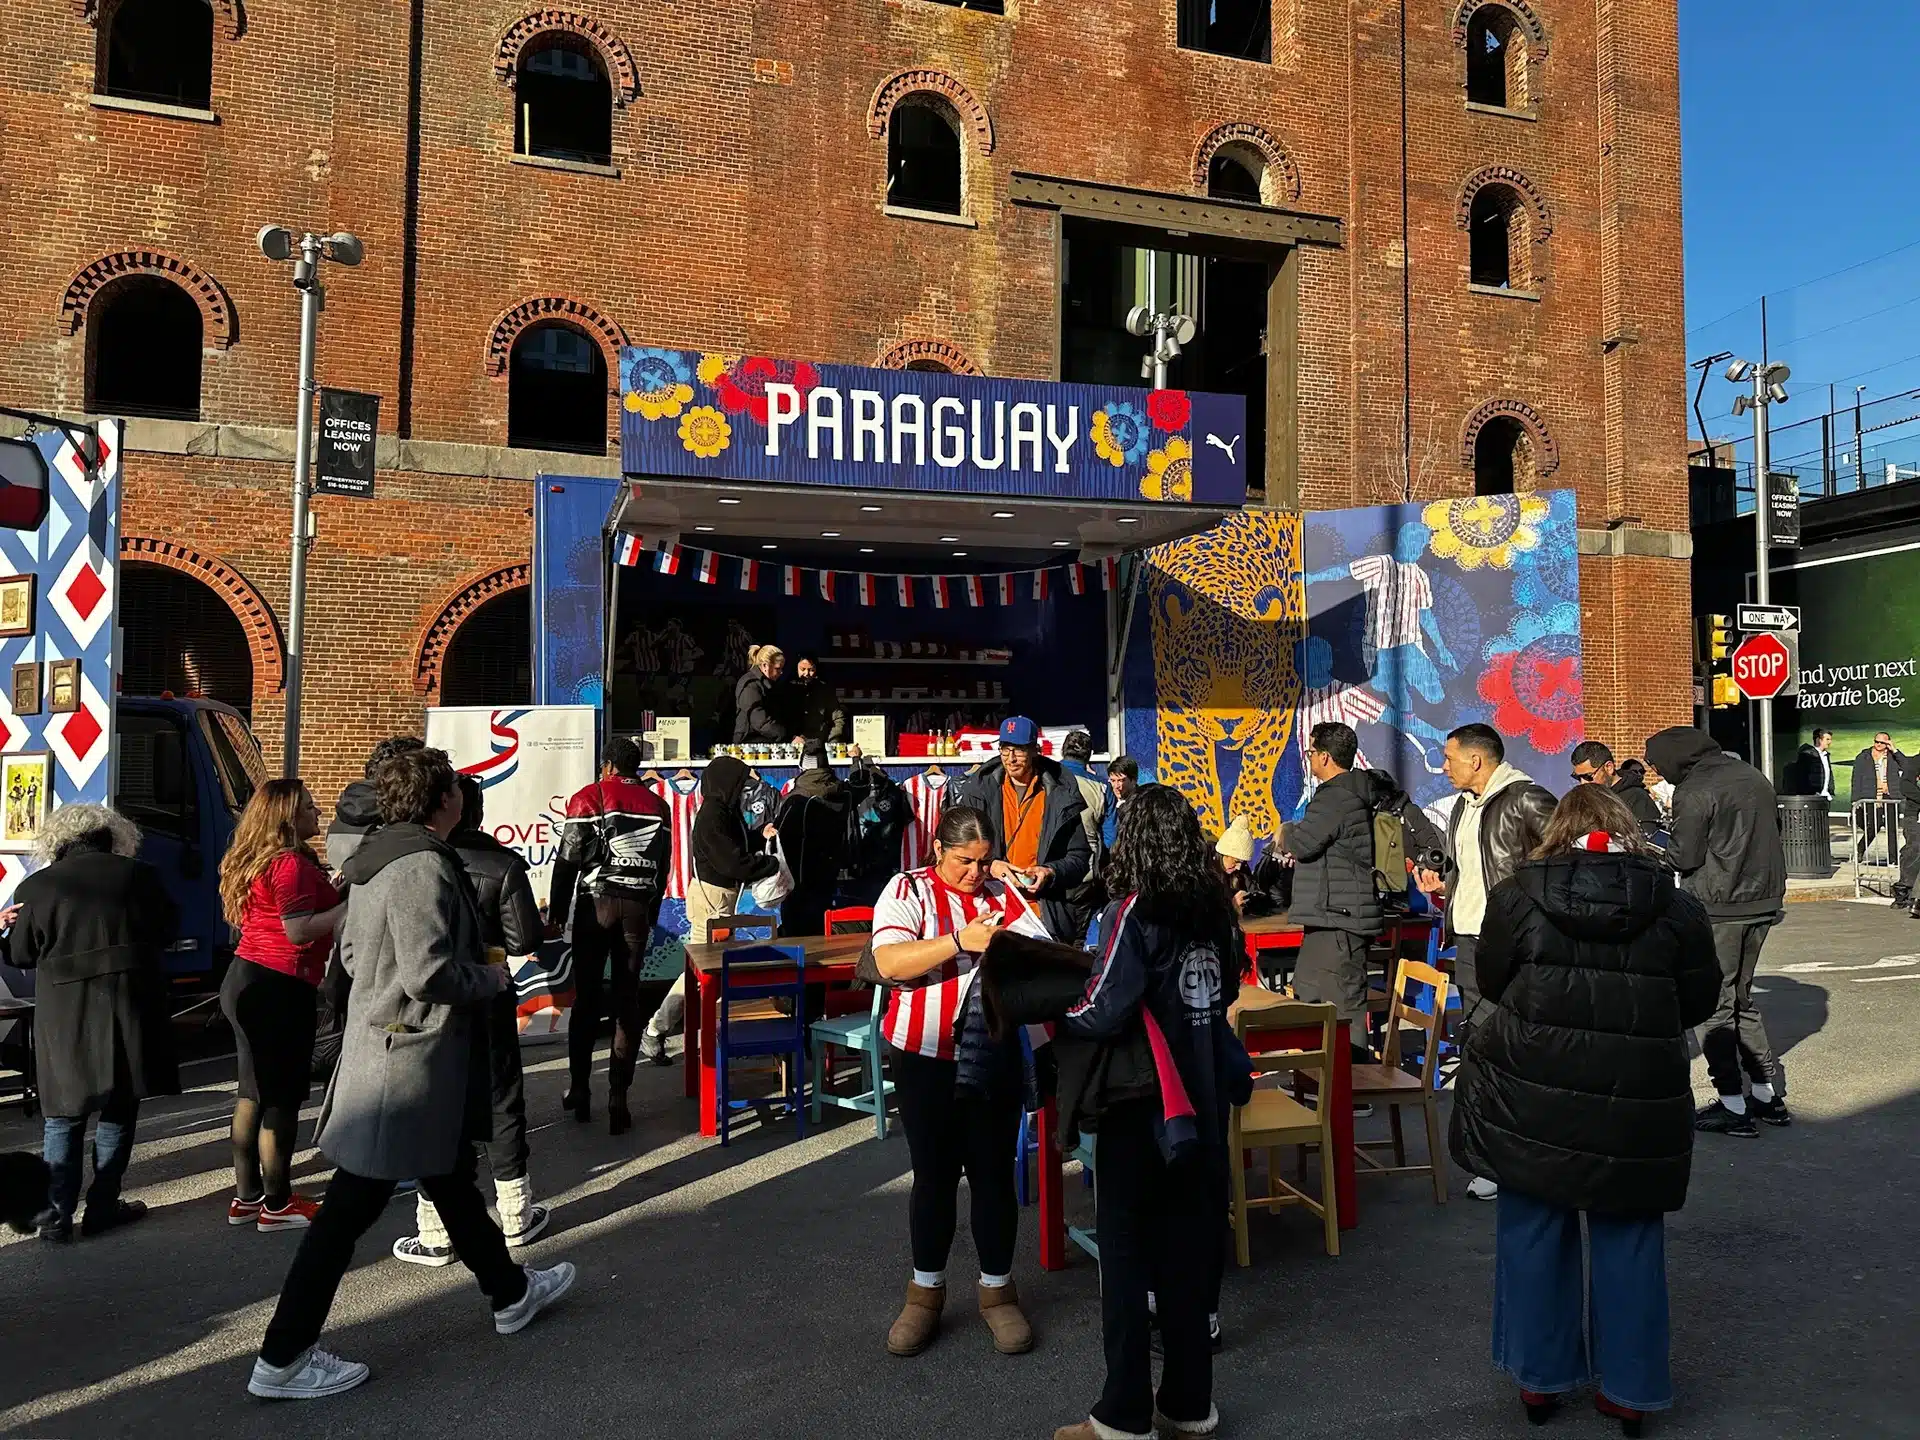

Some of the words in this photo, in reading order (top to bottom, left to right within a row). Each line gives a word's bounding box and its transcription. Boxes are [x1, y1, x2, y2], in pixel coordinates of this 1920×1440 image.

[325, 418, 371, 430] OFFICES
[764, 382, 1080, 474] PARAGUAY
[324, 429, 371, 442] LEASING
[333, 442, 361, 453] NOW
[1771, 494, 1797, 502] OFFICES
[1771, 502, 1797, 510] LEASING
[1776, 510, 1792, 518] NOW
[1748, 612, 1766, 623] ONE
[1772, 614, 1791, 624] WAY
[1737, 653, 1784, 680] STOP
[1798, 664, 1824, 685] ind
[1828, 664, 1870, 687] your
[1874, 657, 1917, 679] next
[1795, 686, 1863, 709] favorite
[1865, 684, 1906, 708] bag.
[480, 823, 549, 845] OVE
[610, 857, 657, 870] HONDA
